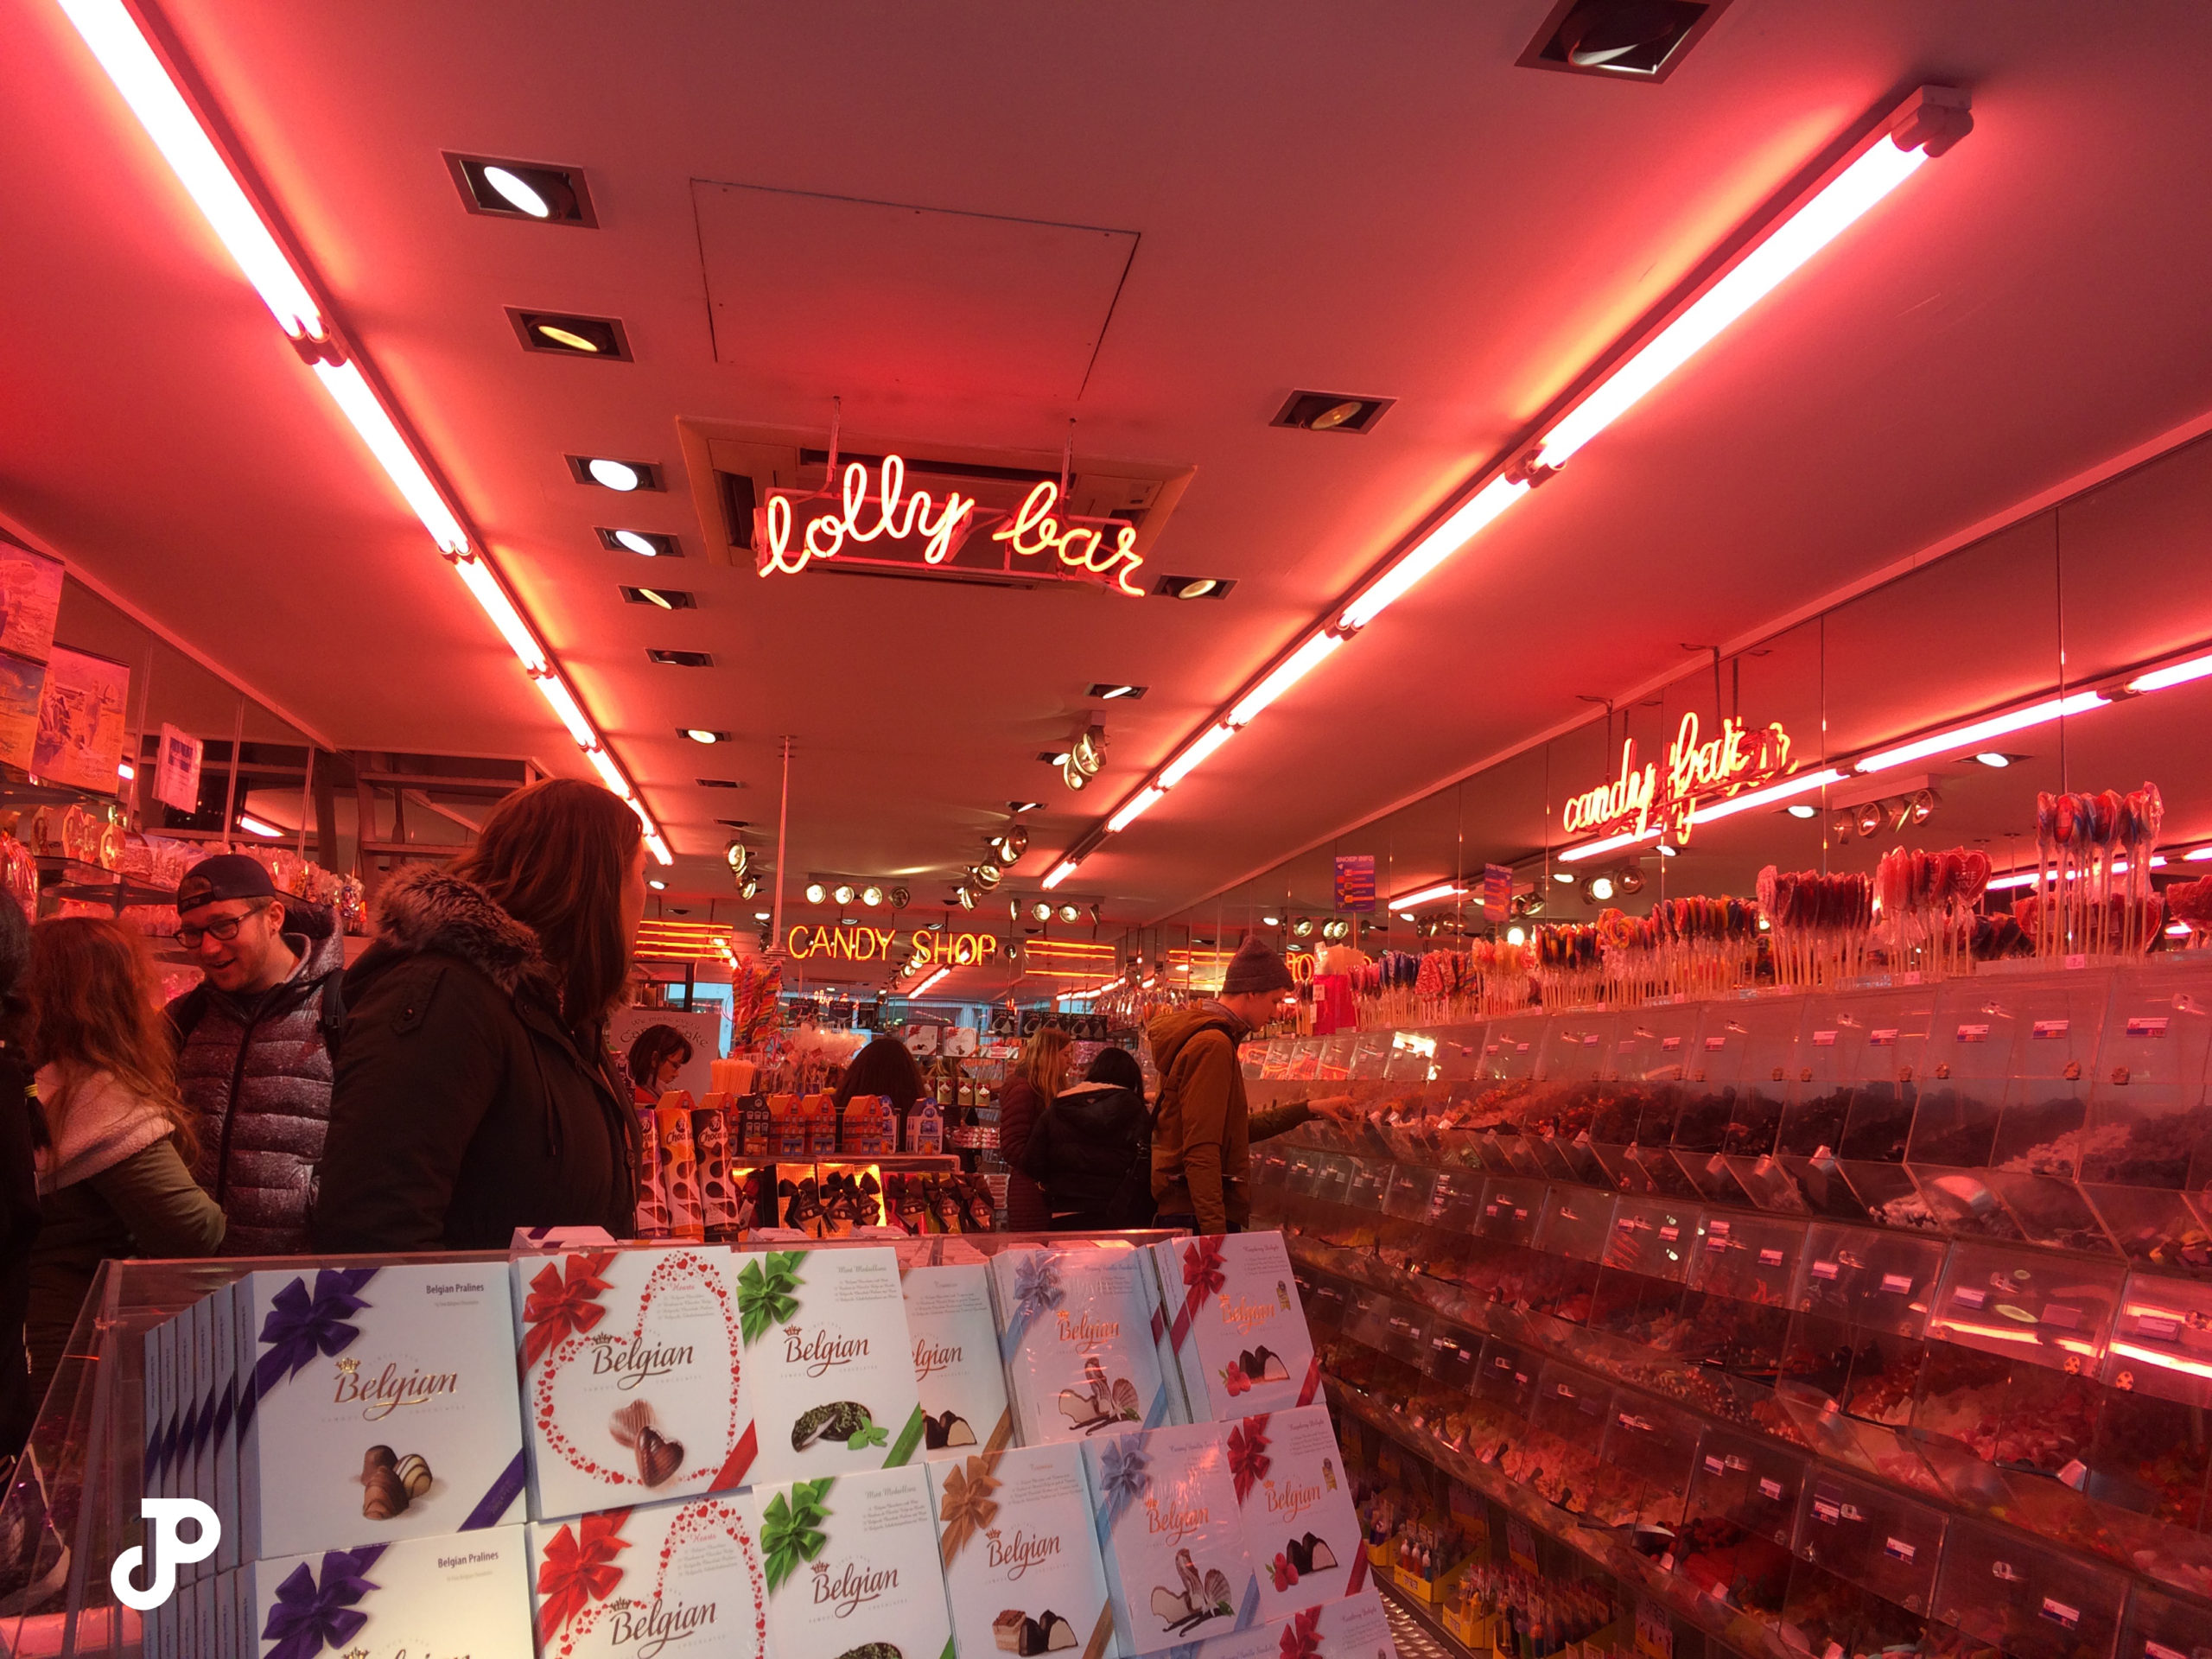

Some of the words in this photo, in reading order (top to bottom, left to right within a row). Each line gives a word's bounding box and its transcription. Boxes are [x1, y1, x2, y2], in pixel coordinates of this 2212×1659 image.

[760, 454, 974, 578] lolly
[993, 481, 1145, 597] bar
[1955, 871, 1977, 880] LOVE
[789, 925, 895, 961] CANDY
[912, 930, 996, 966] SHOP
[426, 1284, 454, 1297] Belgian
[455, 1282, 485, 1294] Pralines
[783, 1328, 870, 1378] Belgian
[1058, 1313, 1121, 1354] Belgian
[591, 1337, 694, 1391] Belgian
[333, 1361, 460, 1421] Belgian
[1265, 1481, 1321, 1523] Belgian
[437, 1554, 467, 1569] Belgian
[468, 1551, 499, 1564] Pralines
[987, 1529, 1062, 1581] Belgian
[810, 1561, 899, 1619] Belgian
[608, 1598, 718, 1659] Belgian
